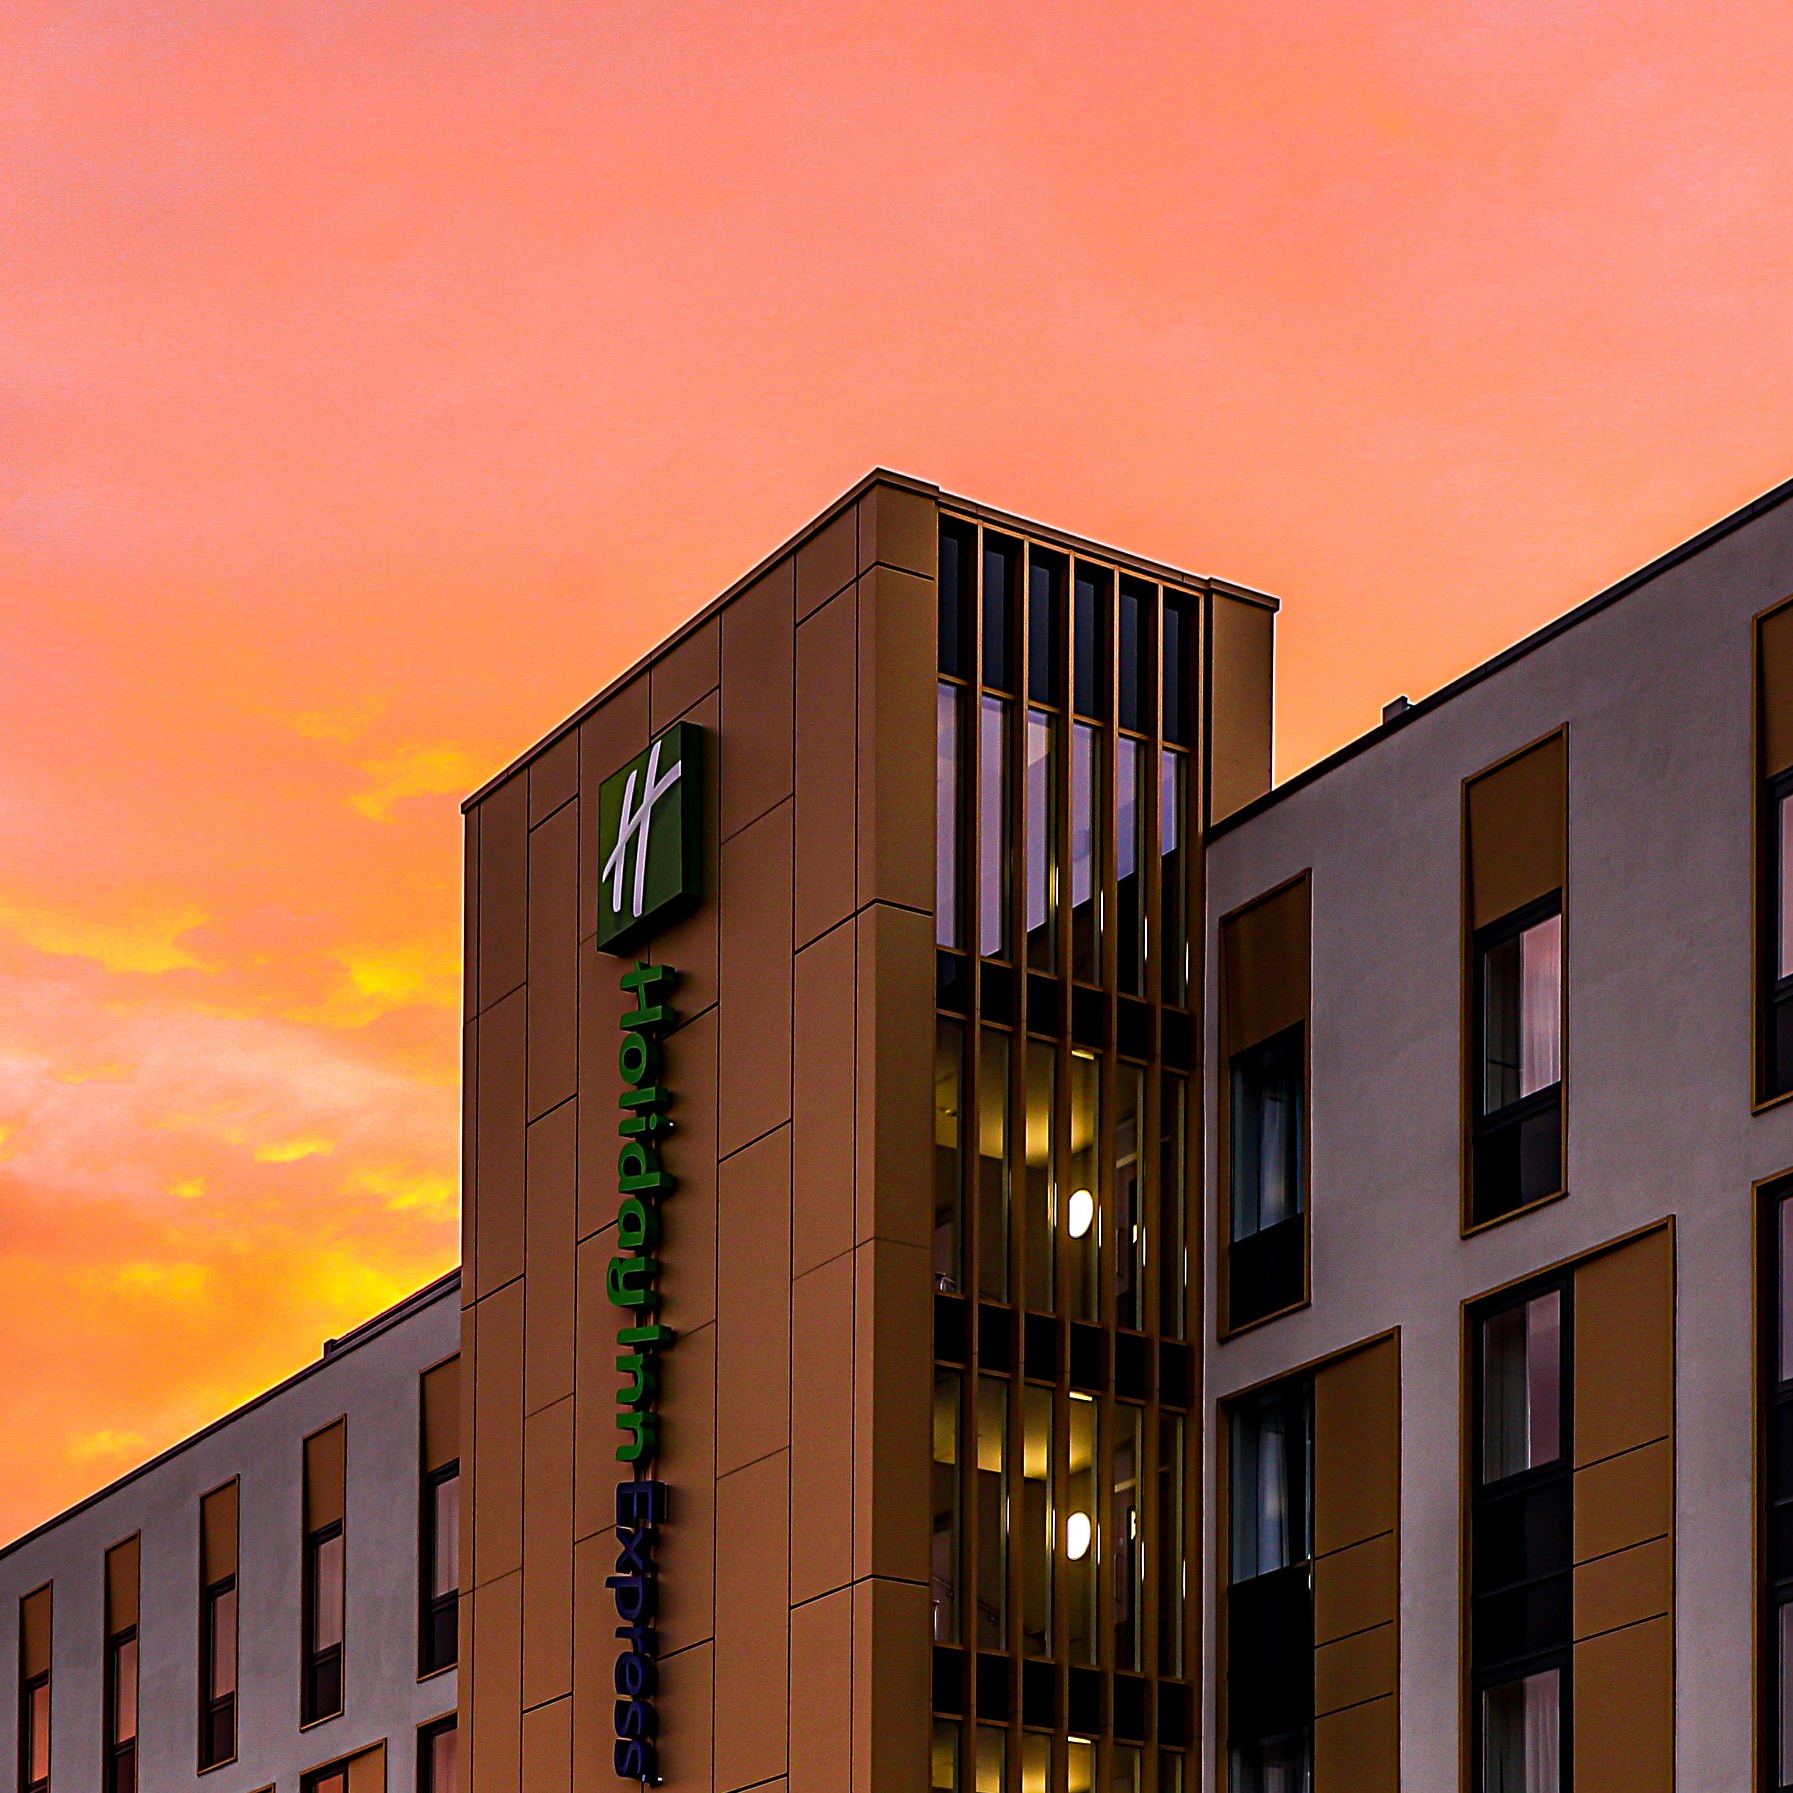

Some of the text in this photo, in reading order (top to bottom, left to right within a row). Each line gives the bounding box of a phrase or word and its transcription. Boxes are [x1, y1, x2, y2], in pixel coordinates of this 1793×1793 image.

[605, 961, 677, 1781] Holiday Inn Express
